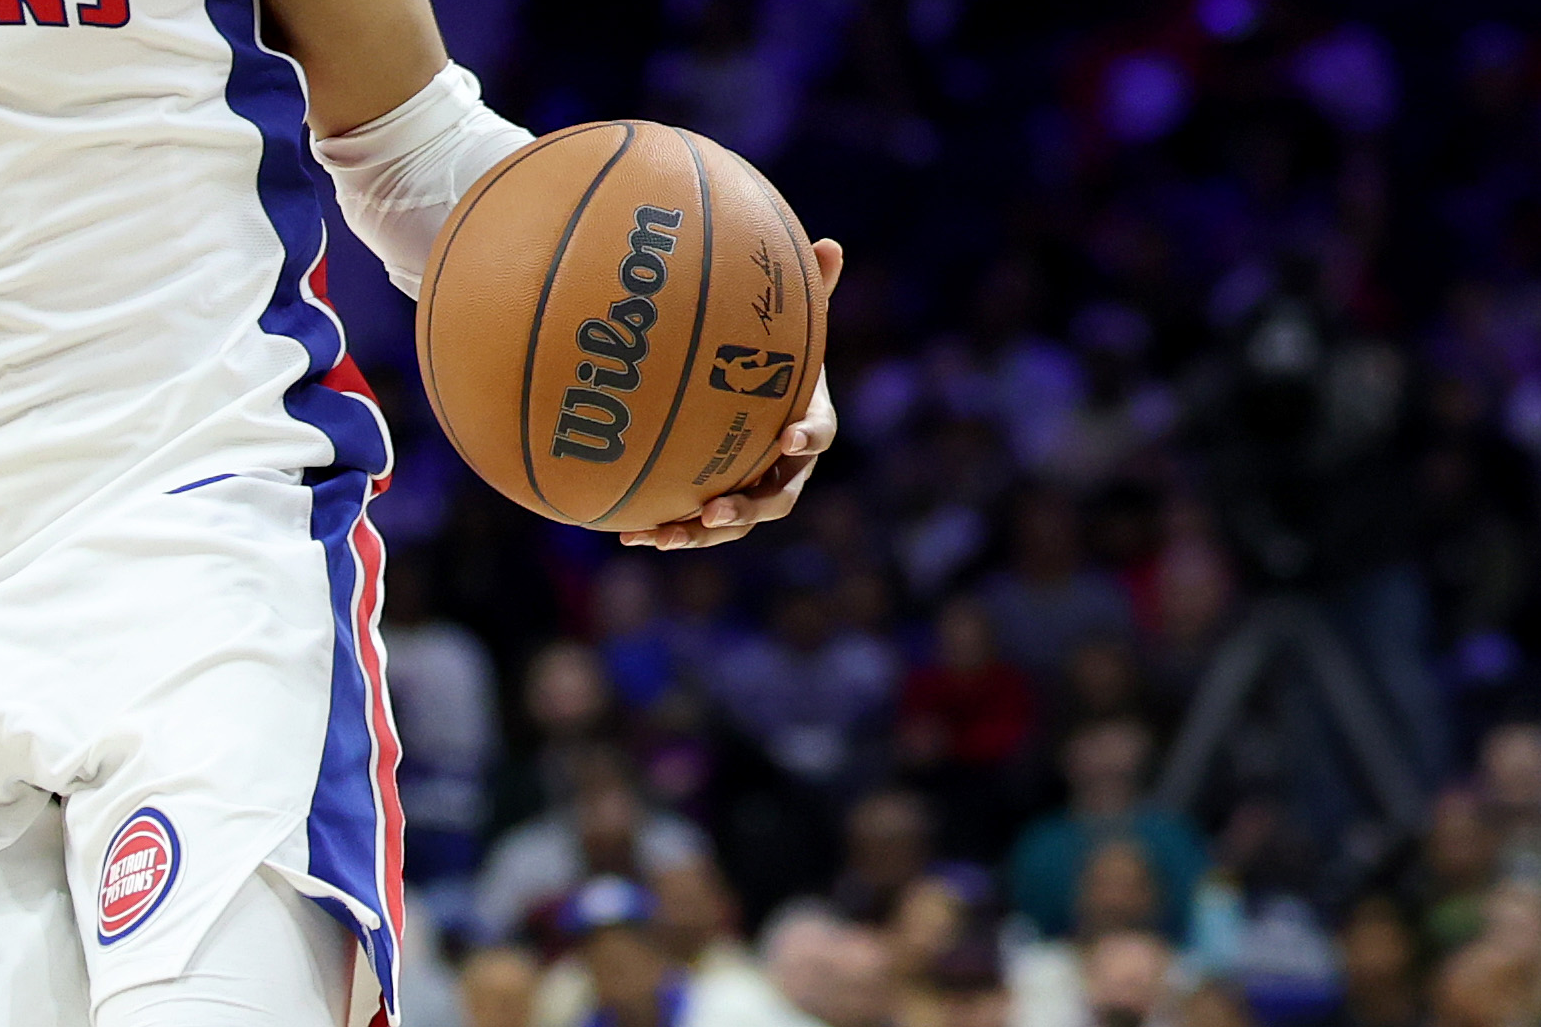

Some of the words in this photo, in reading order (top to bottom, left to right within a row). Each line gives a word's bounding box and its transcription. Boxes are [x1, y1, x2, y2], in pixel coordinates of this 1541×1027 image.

[549, 204, 684, 464] Wilson
[108, 847, 158, 885] DETROIT
[104, 869, 154, 908] PISTONS
